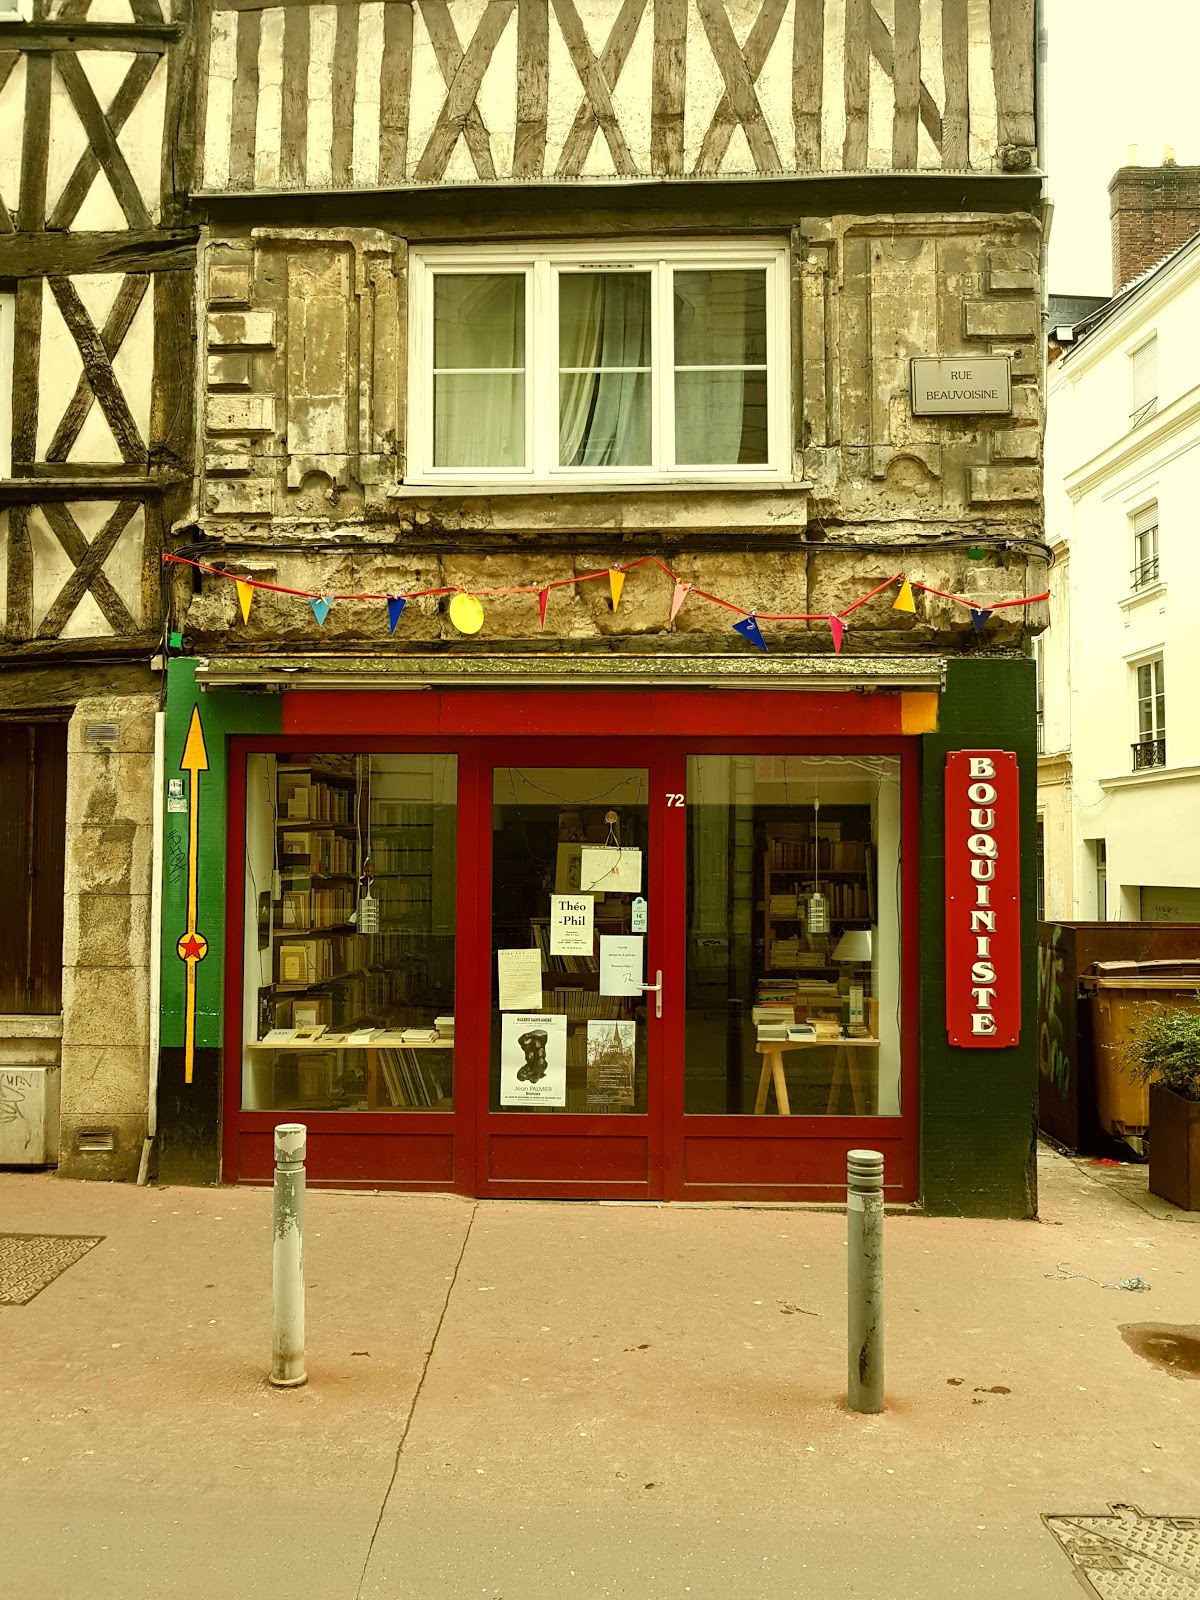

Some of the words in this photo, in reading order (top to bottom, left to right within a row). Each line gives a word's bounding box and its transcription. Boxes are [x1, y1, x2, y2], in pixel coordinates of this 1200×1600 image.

[950, 370, 973, 380] RUE
[926, 389, 999, 400] BEAUVOISINE
[665, 793, 685, 807] 72
[967, 757, 998, 1036] BOUQUINISTE
[558, 900, 587, 911] Théo
[558, 915, 586, 926] -Phil
